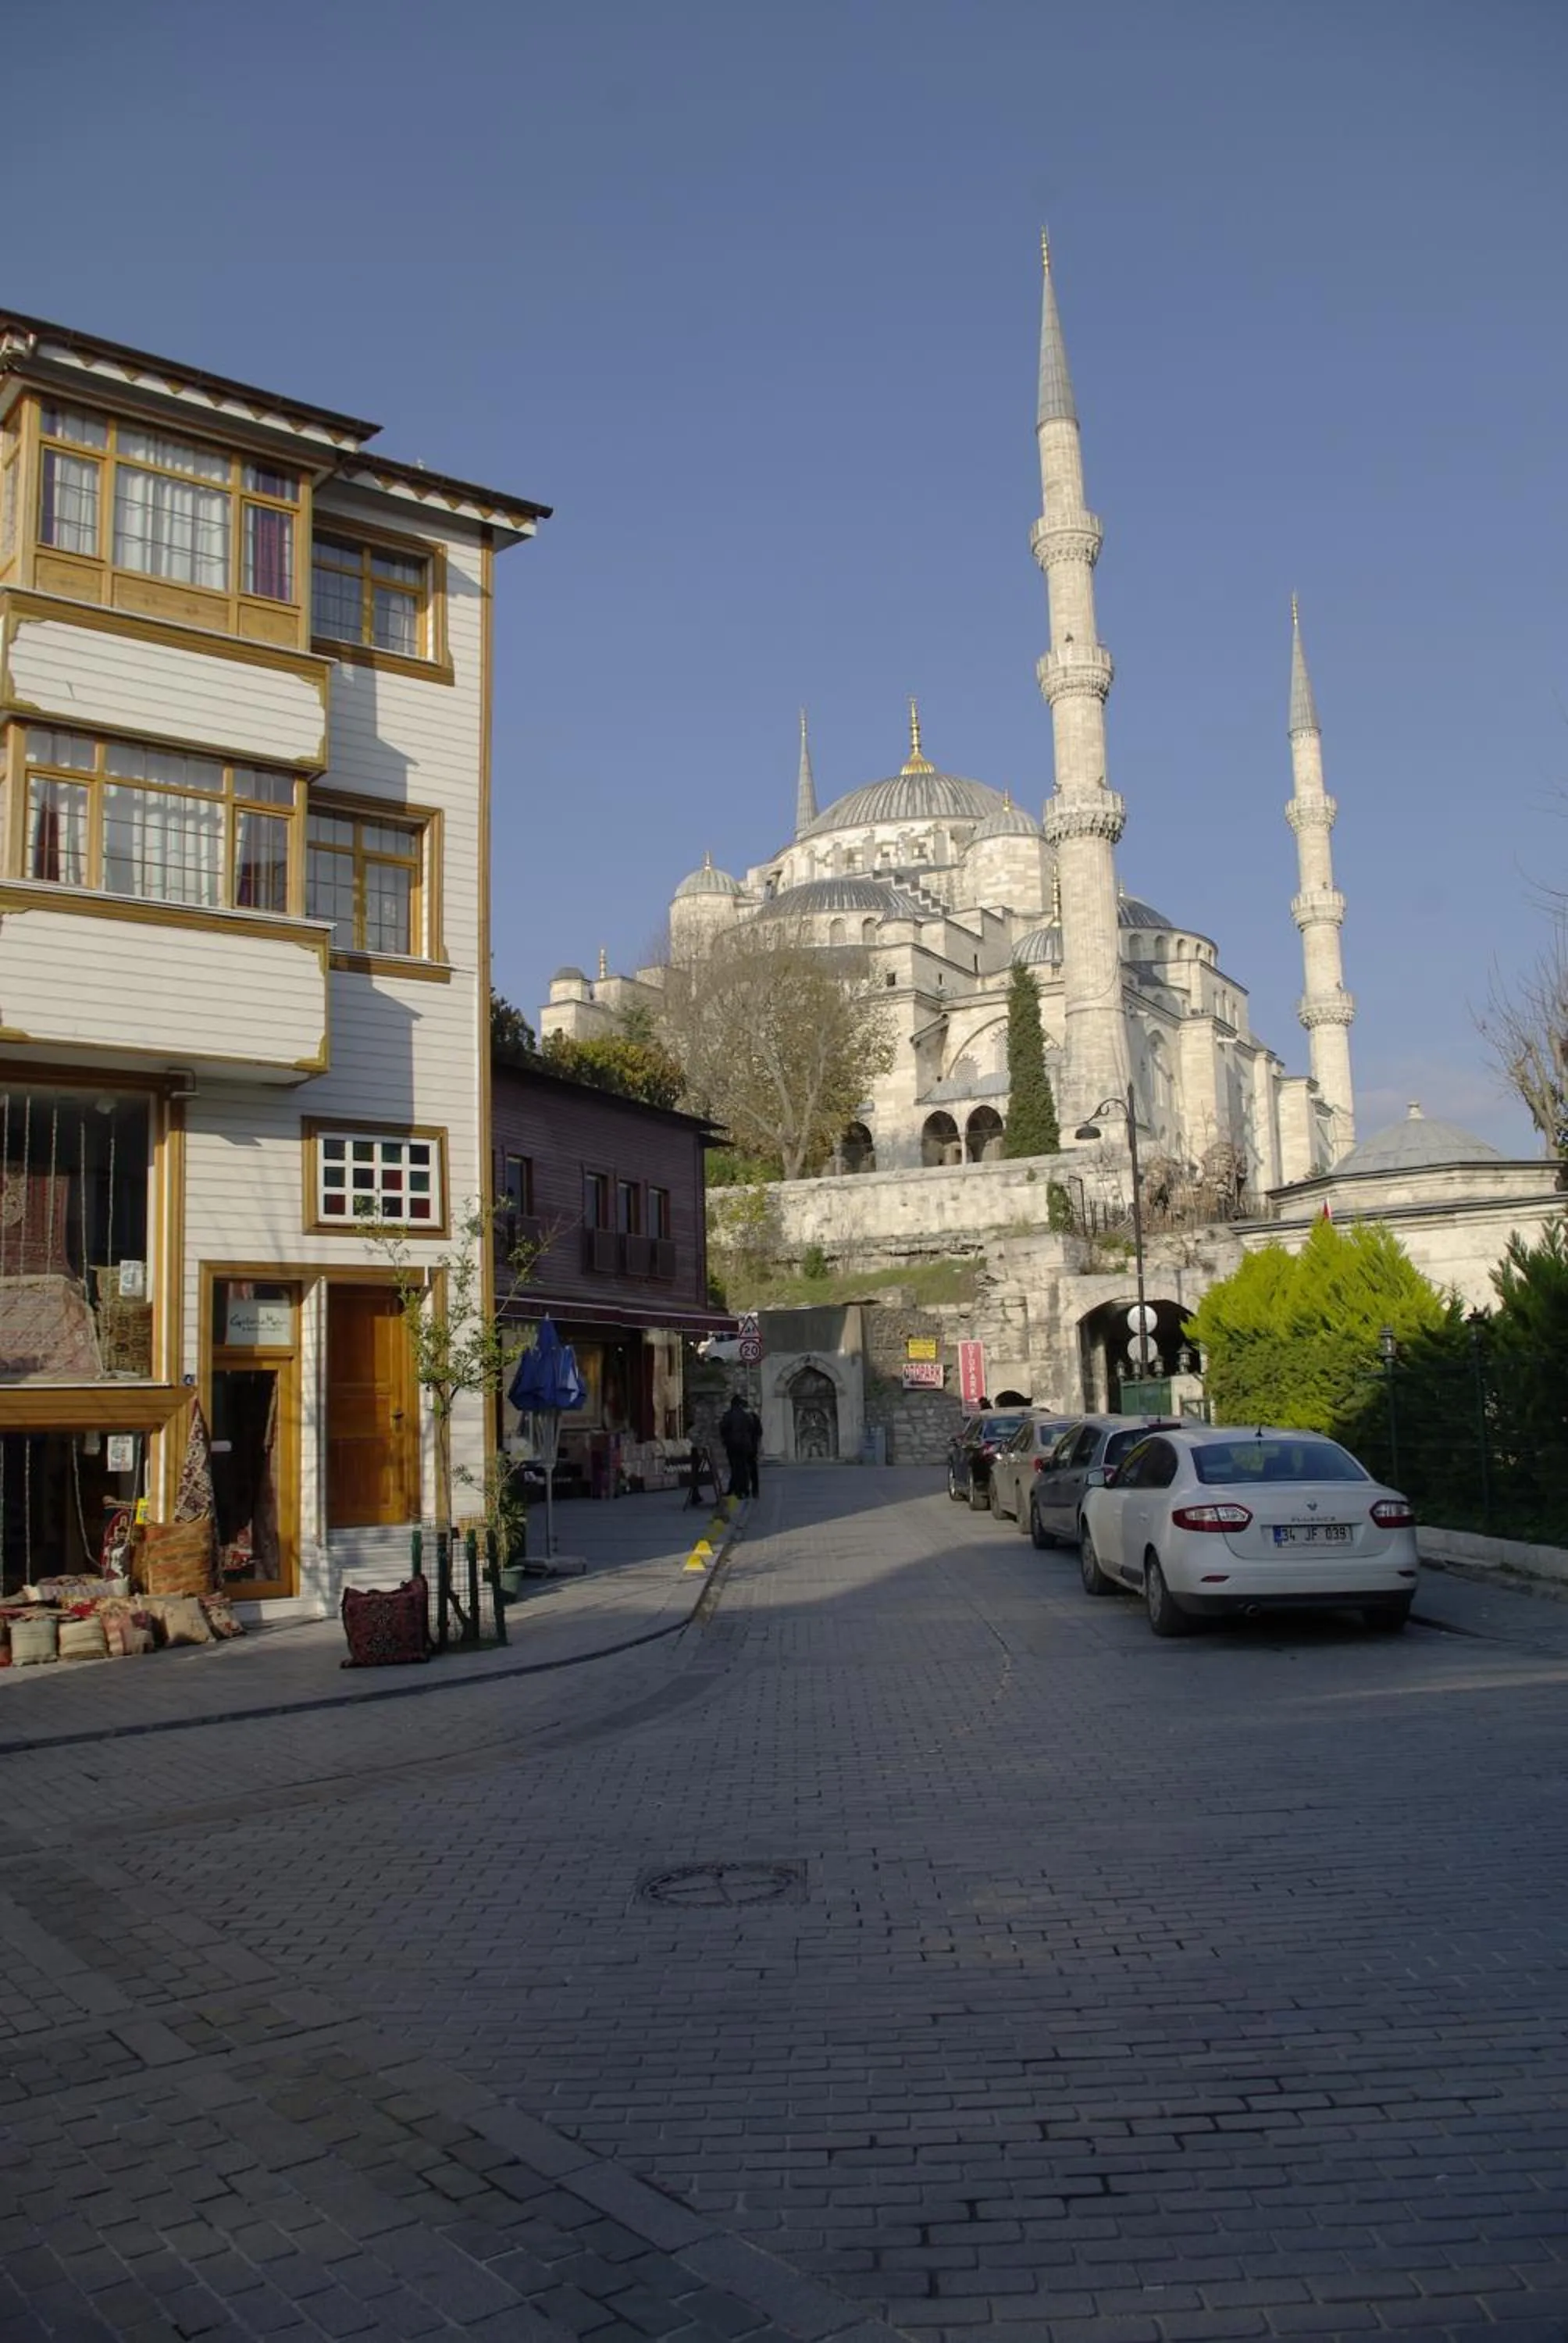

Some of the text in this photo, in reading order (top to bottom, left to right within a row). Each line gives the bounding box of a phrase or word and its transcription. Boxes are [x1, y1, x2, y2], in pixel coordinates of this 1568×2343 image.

[744, 1346, 757, 1357] 20
[904, 1364, 941, 1381] OTOPARK
[967, 1343, 978, 1397] OTOPARK
[1281, 1527, 1295, 1542] 34
[1305, 1526, 1318, 1541] JF
